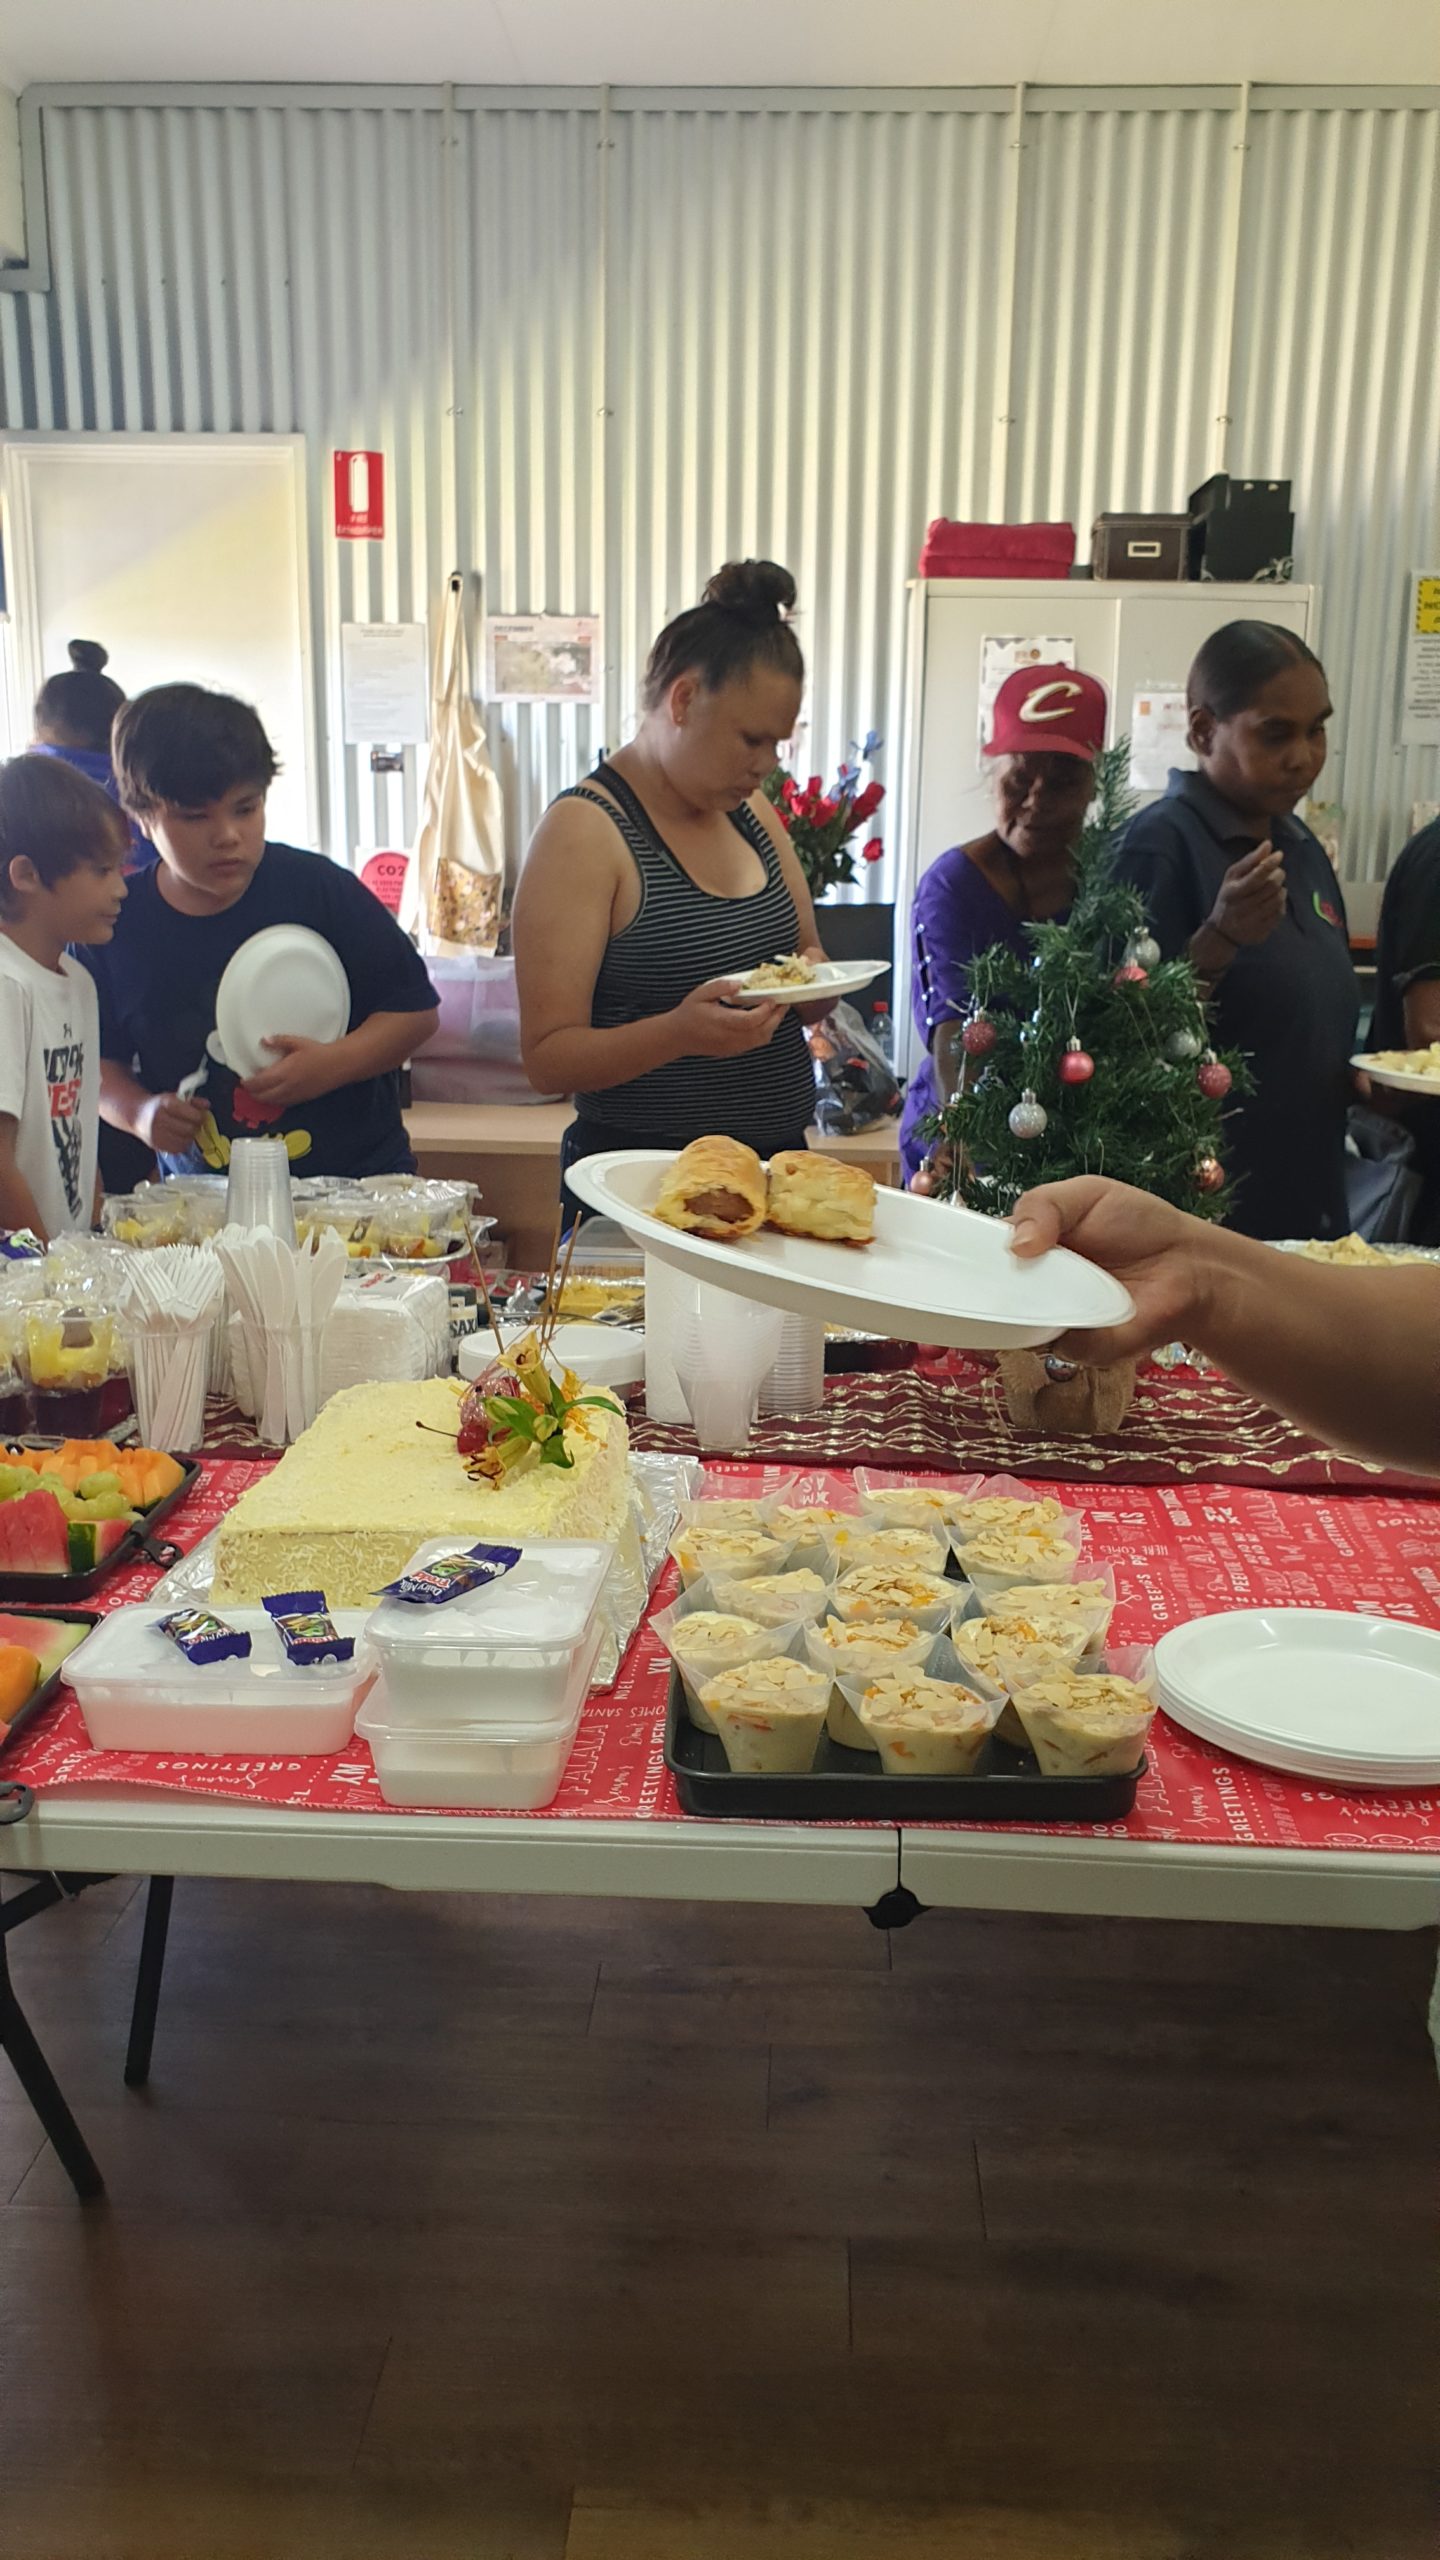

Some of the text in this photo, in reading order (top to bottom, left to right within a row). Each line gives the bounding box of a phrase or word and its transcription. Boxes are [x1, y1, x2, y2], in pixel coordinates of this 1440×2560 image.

[1018, 681, 1084, 723] C
[377, 864, 406, 877] CO2
[613, 1679, 635, 1700] NOEL
[629, 1704, 666, 1718] OMES
[155, 1761, 301, 1772] GREETINGS
[634, 1748, 666, 1819] GREETINGS
[1177, 1784, 1221, 1829] Season's
[1211, 1766, 1255, 1842] GREETINGS
